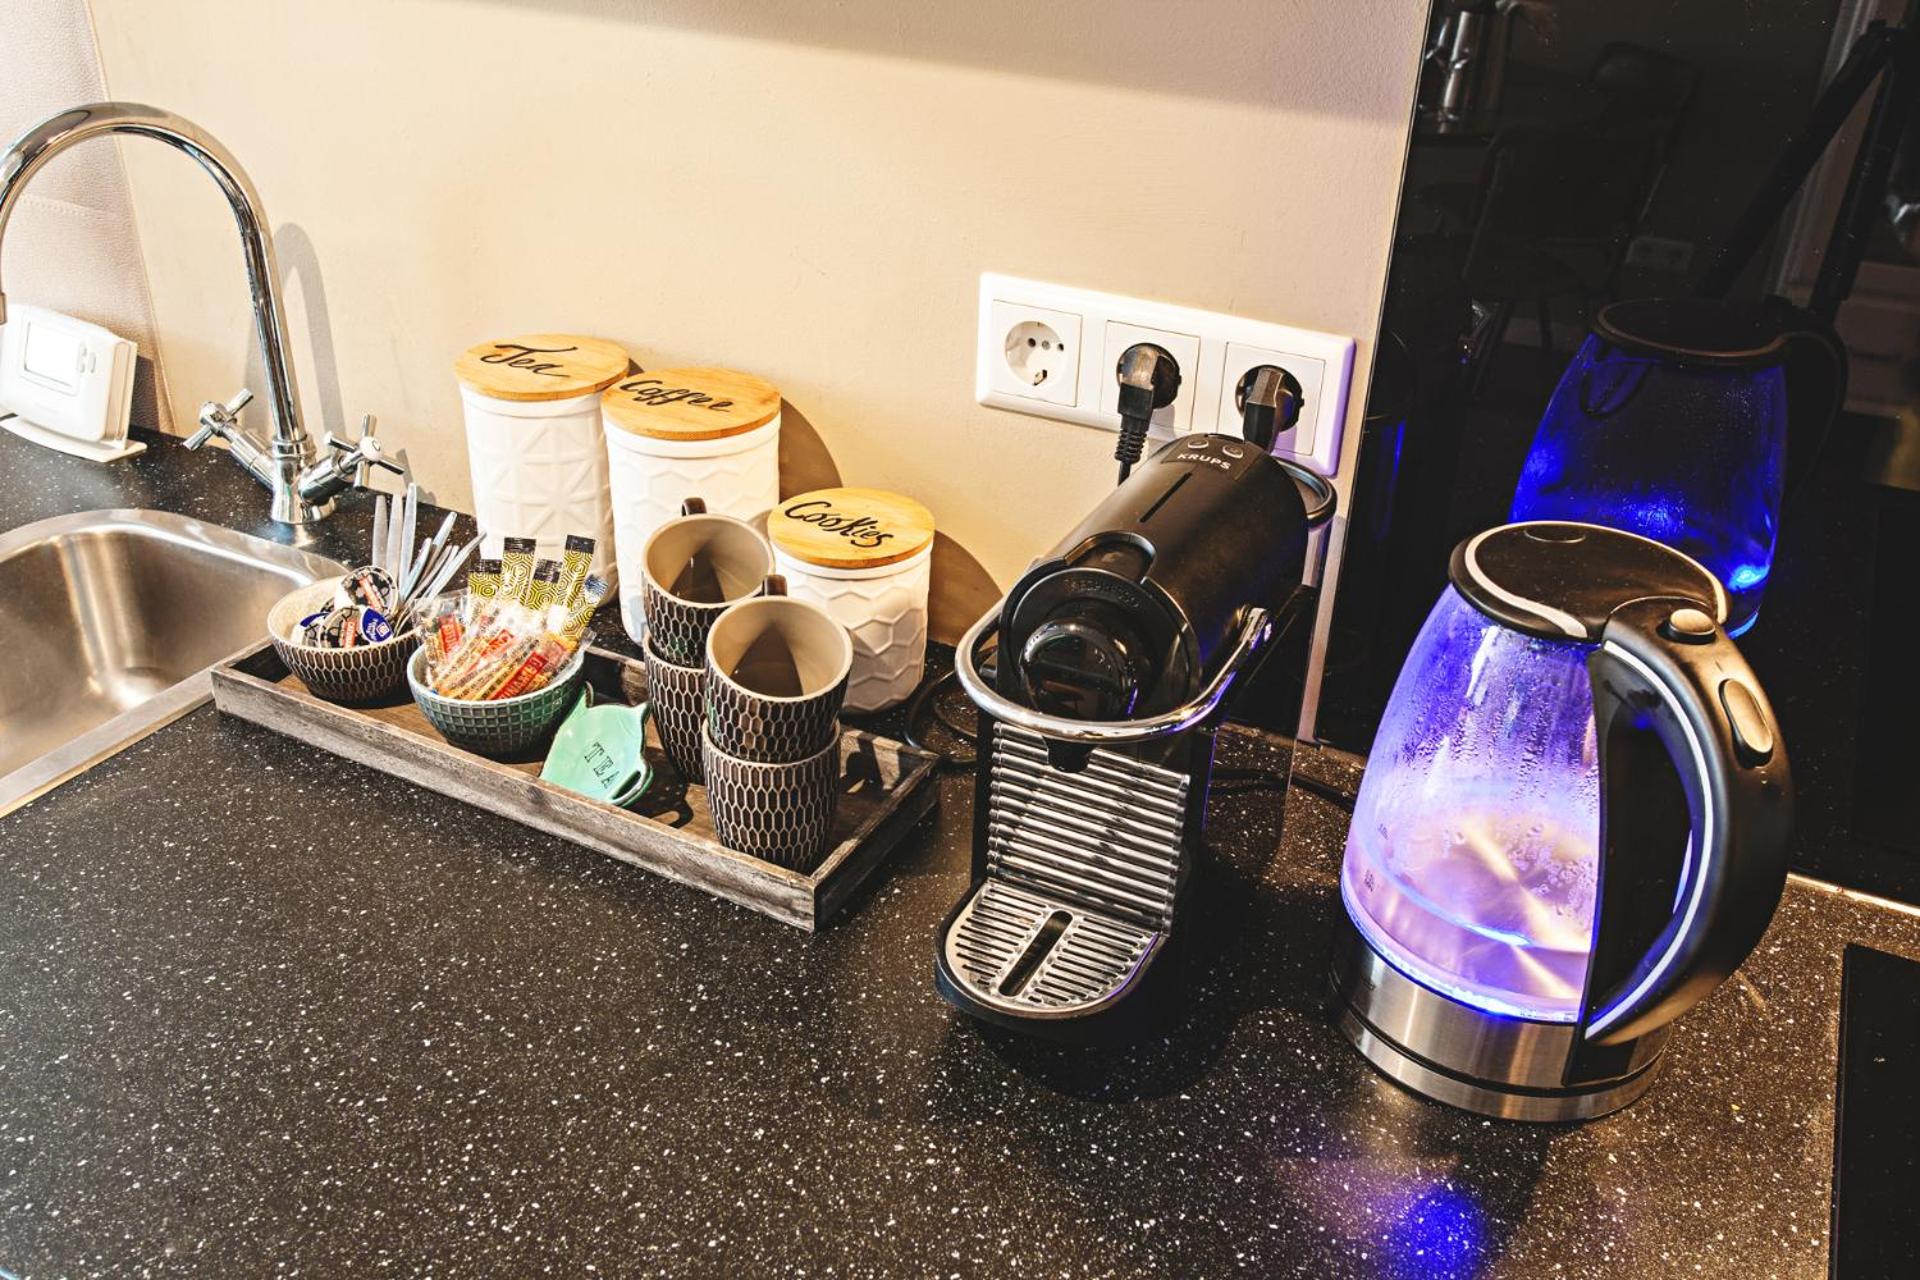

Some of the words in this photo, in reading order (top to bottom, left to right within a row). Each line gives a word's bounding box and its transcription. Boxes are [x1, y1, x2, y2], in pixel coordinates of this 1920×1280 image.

[480, 344, 578, 378] Tea
[619, 380, 734, 412] Coffee
[1177, 453, 1231, 469] KRUPS
[784, 501, 894, 548] Cookies
[584, 741, 620, 790] TEA
